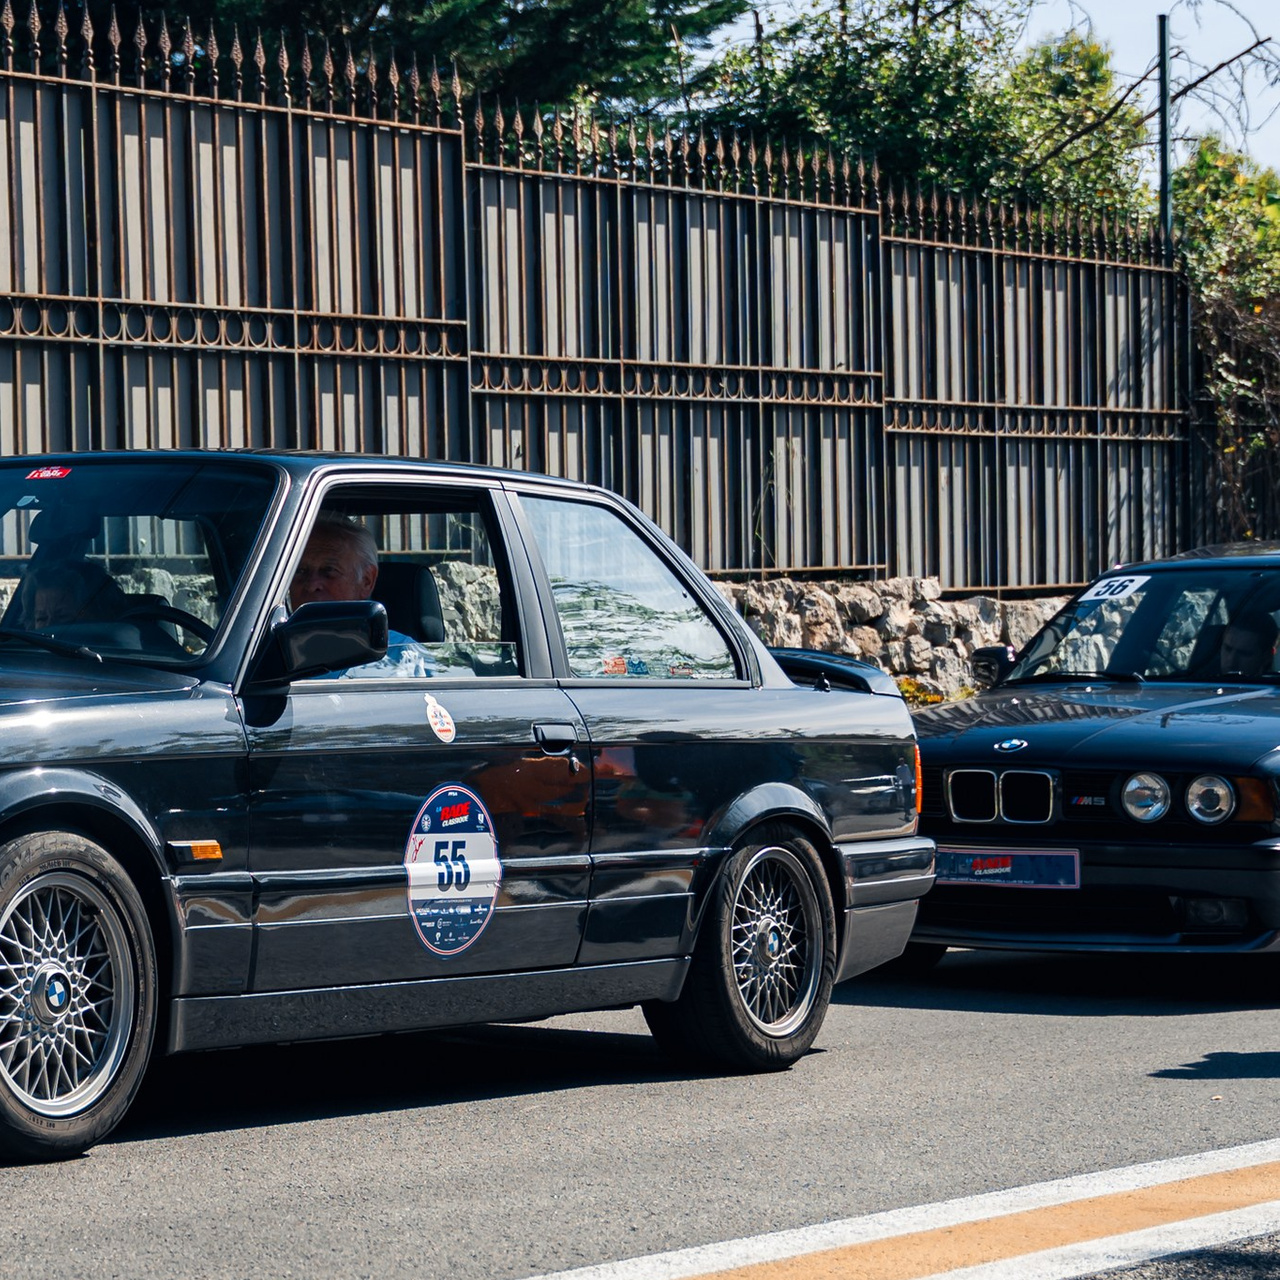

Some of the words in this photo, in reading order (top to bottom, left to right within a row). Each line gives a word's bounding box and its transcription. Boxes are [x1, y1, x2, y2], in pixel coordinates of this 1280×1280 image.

[1093, 578, 1136, 597] 56
[1080, 796, 1106, 806] M5
[441, 801, 472, 821] RADE
[433, 840, 471, 893] 55
[974, 866, 1012, 876] CLASSIQUE
